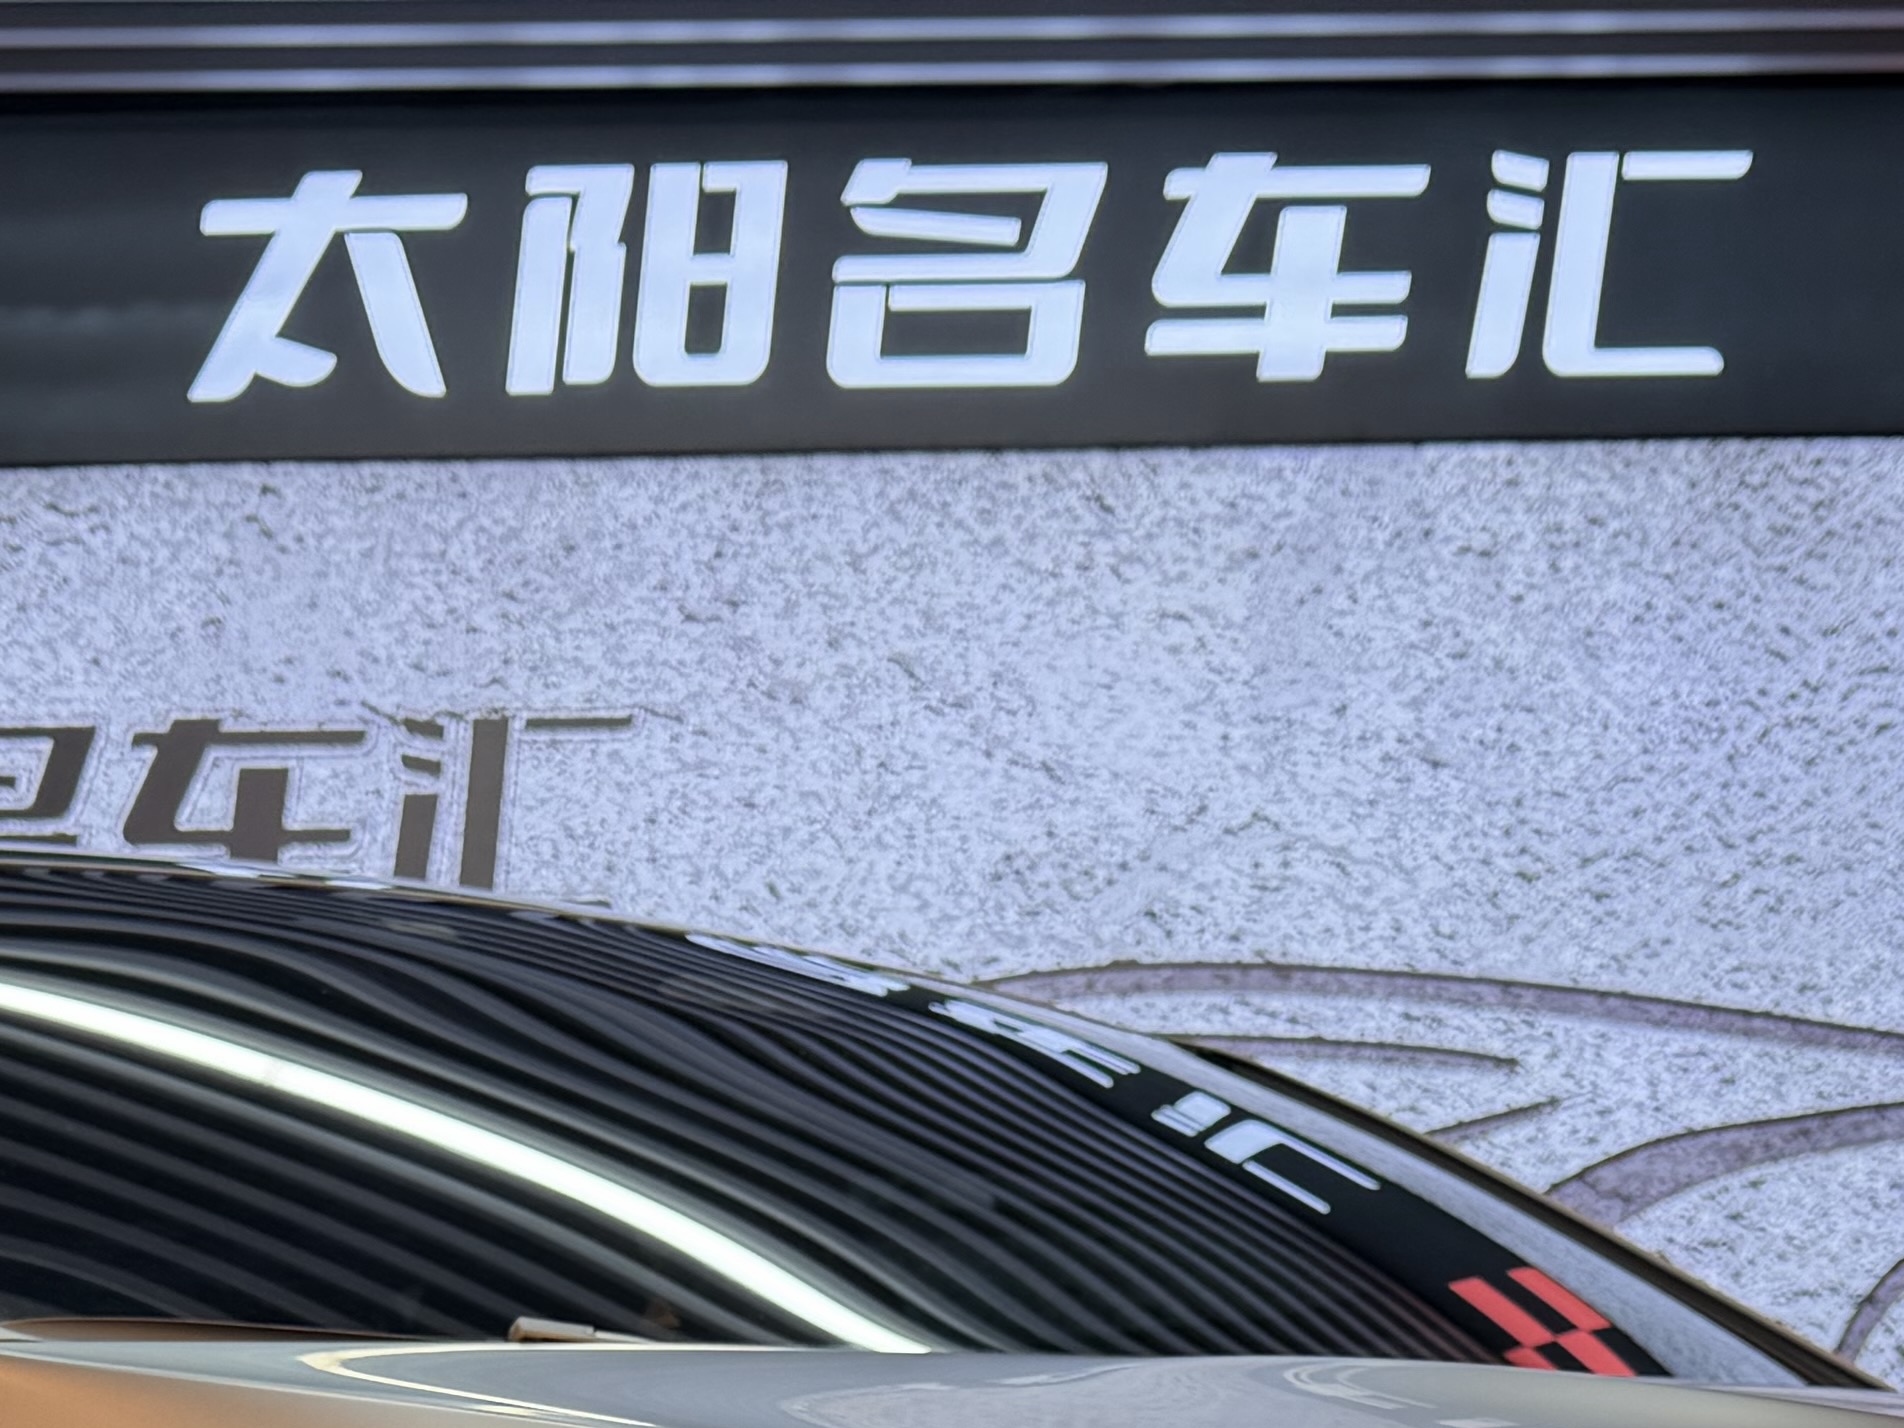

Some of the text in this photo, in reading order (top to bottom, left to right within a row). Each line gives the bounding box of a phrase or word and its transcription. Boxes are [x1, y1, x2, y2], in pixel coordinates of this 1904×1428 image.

[188, 148, 1754, 406] 太阳名车汇
